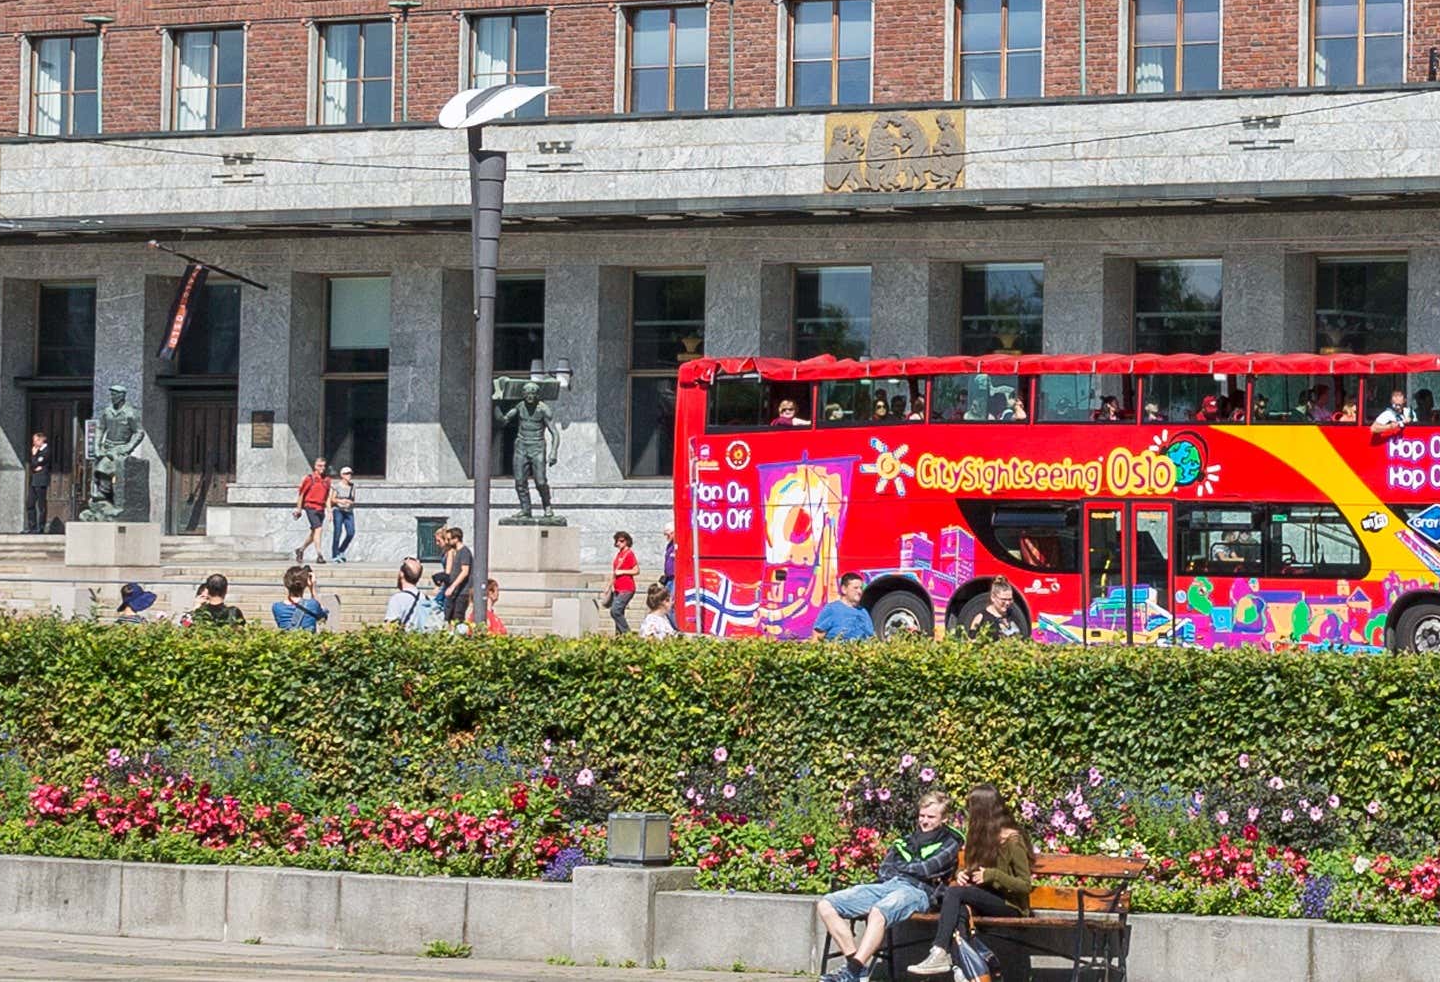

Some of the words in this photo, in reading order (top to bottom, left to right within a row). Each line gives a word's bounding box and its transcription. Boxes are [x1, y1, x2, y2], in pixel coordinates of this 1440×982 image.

[1389, 437, 1425, 460] Hop
[917, 454, 1101, 495] CitySightseeing
[1109, 449, 1174, 493] Oslo
[1389, 466, 1425, 489] Hop
[727, 481, 749, 503] On
[727, 508, 753, 529] Off
